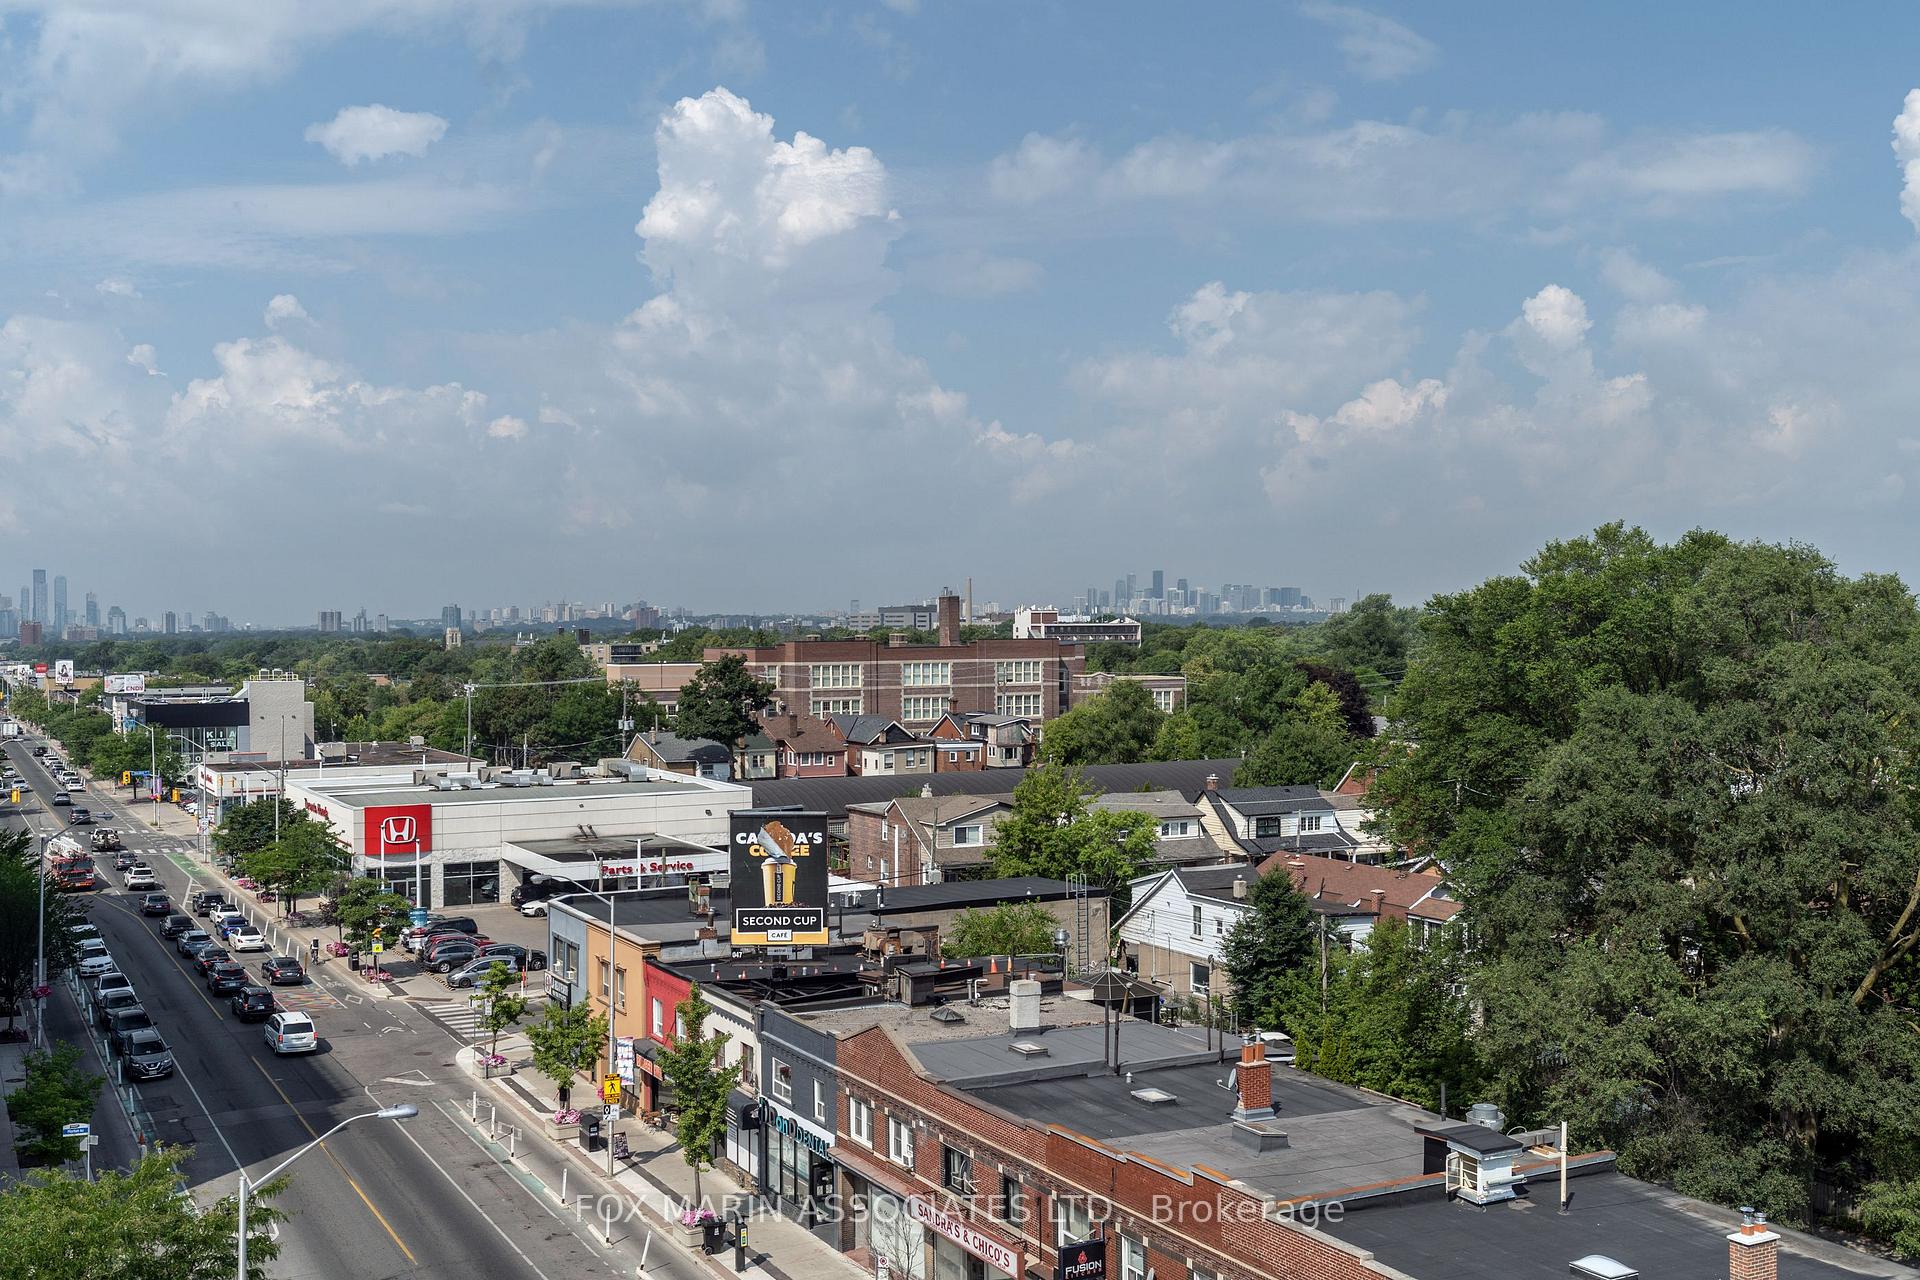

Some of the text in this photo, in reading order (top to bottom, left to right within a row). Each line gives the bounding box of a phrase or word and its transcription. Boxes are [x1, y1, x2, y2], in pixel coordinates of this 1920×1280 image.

[601, 864, 633, 875] Parts
[649, 860, 694, 872] Service
[742, 916, 817, 926] SECOND CUP
[918, 1204, 960, 1239] SANDRA'S
[963, 1229, 971, 1246] &
[972, 1235, 1011, 1268] CHICO'S
[1065, 1260, 1102, 1276] FUSION
